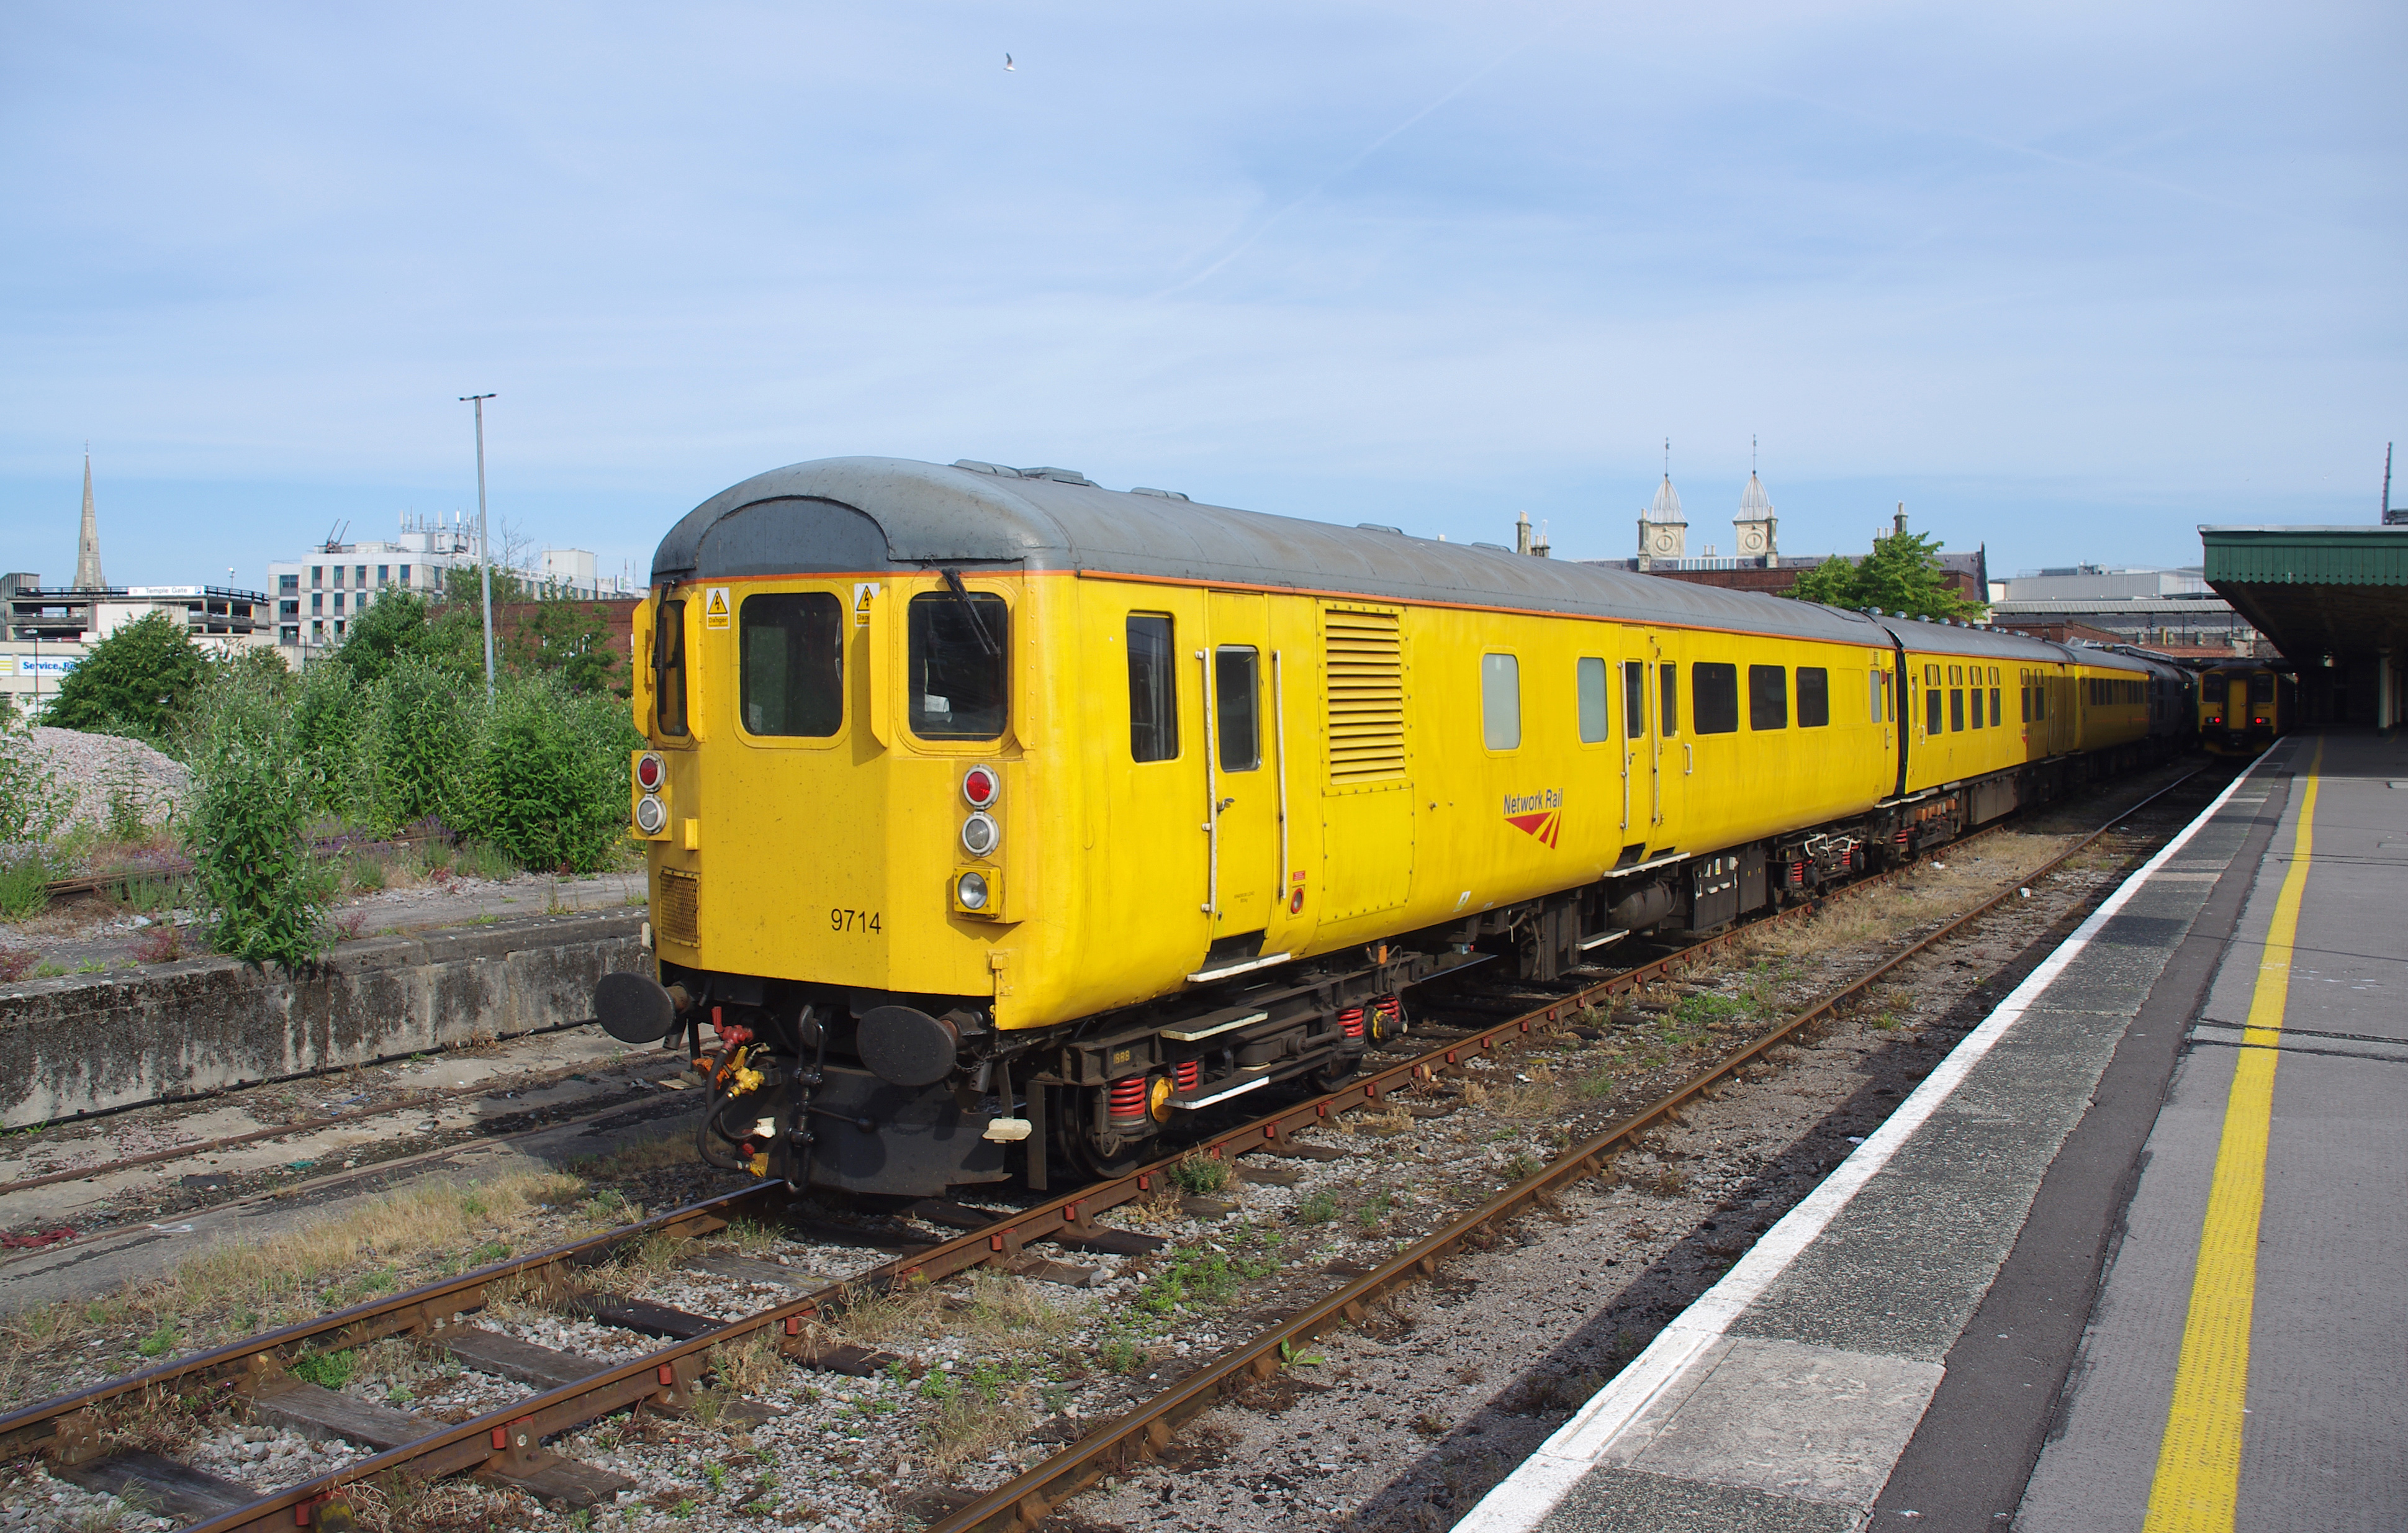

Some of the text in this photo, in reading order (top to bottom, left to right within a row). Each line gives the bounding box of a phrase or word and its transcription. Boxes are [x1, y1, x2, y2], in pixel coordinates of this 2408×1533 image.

[1504, 787, 1563, 815] Network Rail
[831, 908, 882, 934] 9714
